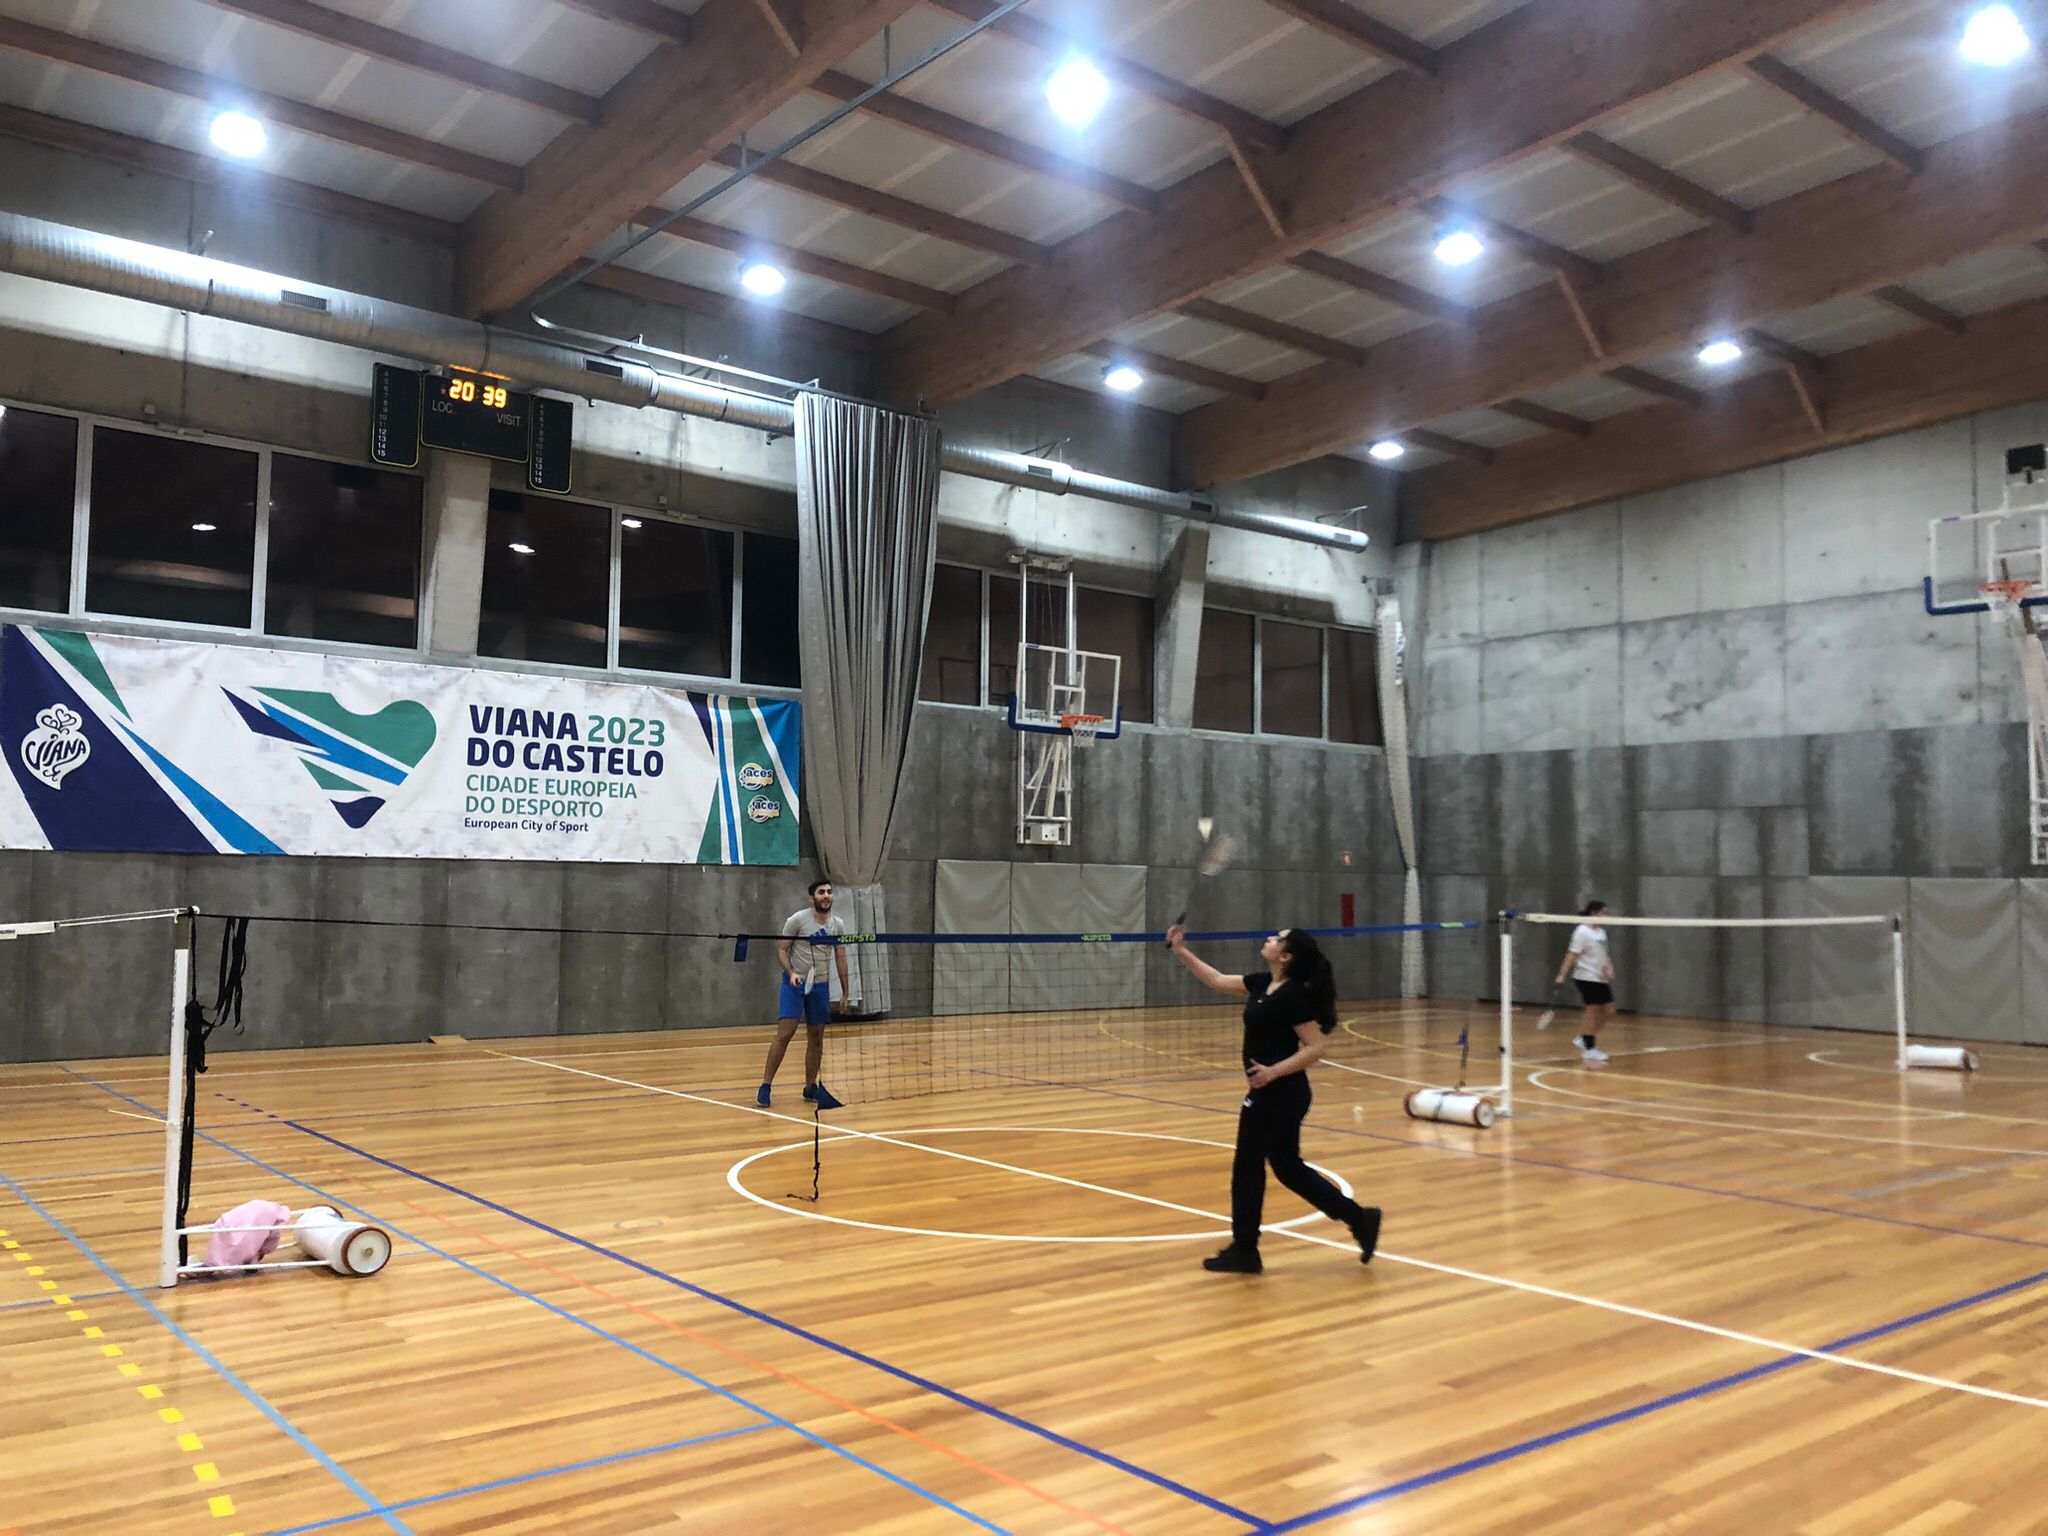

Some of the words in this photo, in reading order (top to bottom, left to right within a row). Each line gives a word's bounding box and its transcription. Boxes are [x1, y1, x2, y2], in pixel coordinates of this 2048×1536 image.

[378, 428, 387, 436] 12
[377, 449, 386, 457] 15
[469, 704, 580, 741] VIANA
[587, 714, 666, 747] 2023
[466, 737, 515, 768] DO
[523, 741, 665, 778] CASTELO
[746, 769, 773, 778] aces
[466, 774, 540, 795] CIDADE
[545, 778, 638, 799] EUROPEIA
[465, 796, 495, 814] DO
[501, 797, 604, 818] DESPORTO
[754, 801, 779, 810] aces
[464, 817, 518, 831] European
[521, 819, 543, 833] City
[545, 820, 557, 831] of
[559, 821, 589, 834] Sport
